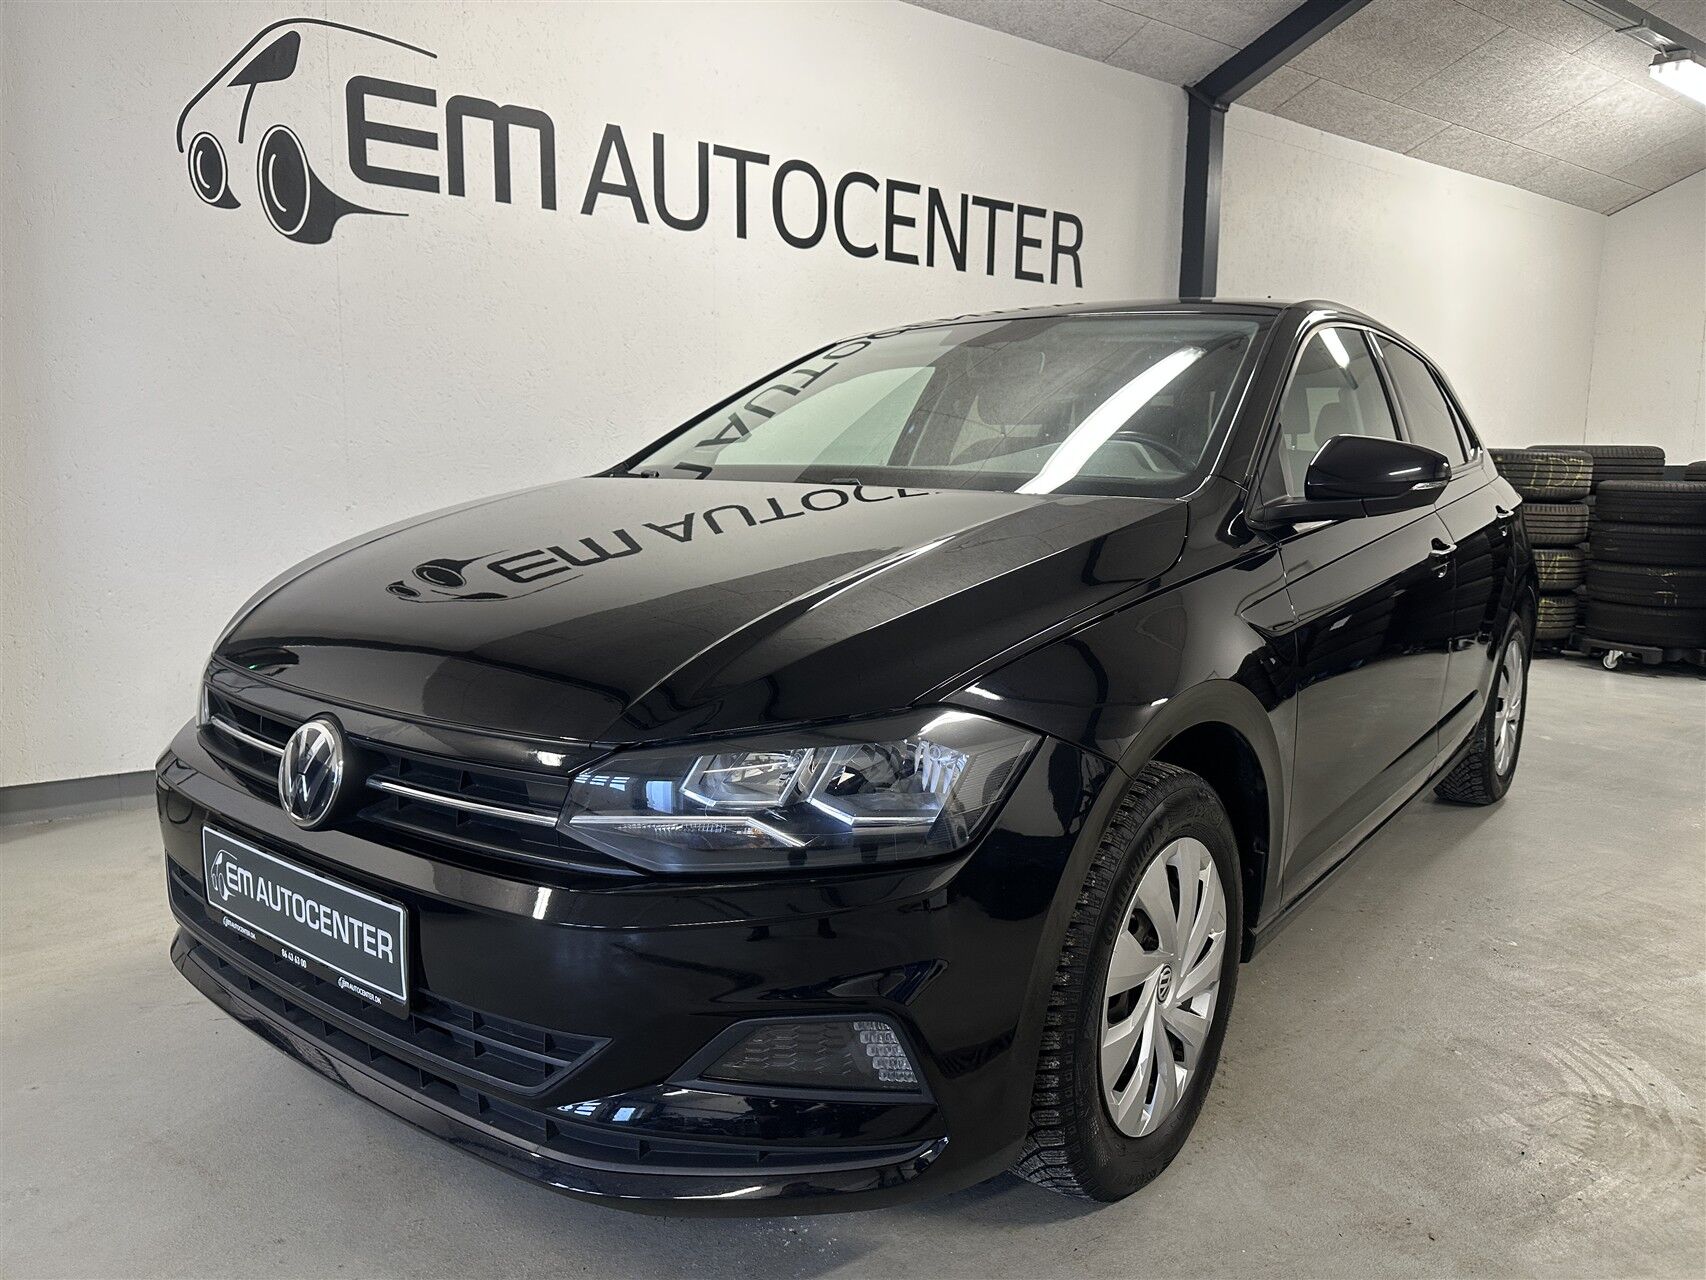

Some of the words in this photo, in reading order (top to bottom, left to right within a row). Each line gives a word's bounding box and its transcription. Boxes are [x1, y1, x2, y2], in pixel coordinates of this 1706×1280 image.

[345, 75, 557, 211] EM
[580, 123, 1084, 289] AUTOCENTER
[226, 862, 254, 899] EM
[256, 876, 394, 964] AUTOCENTER
[300, 958, 307, 969] 00
